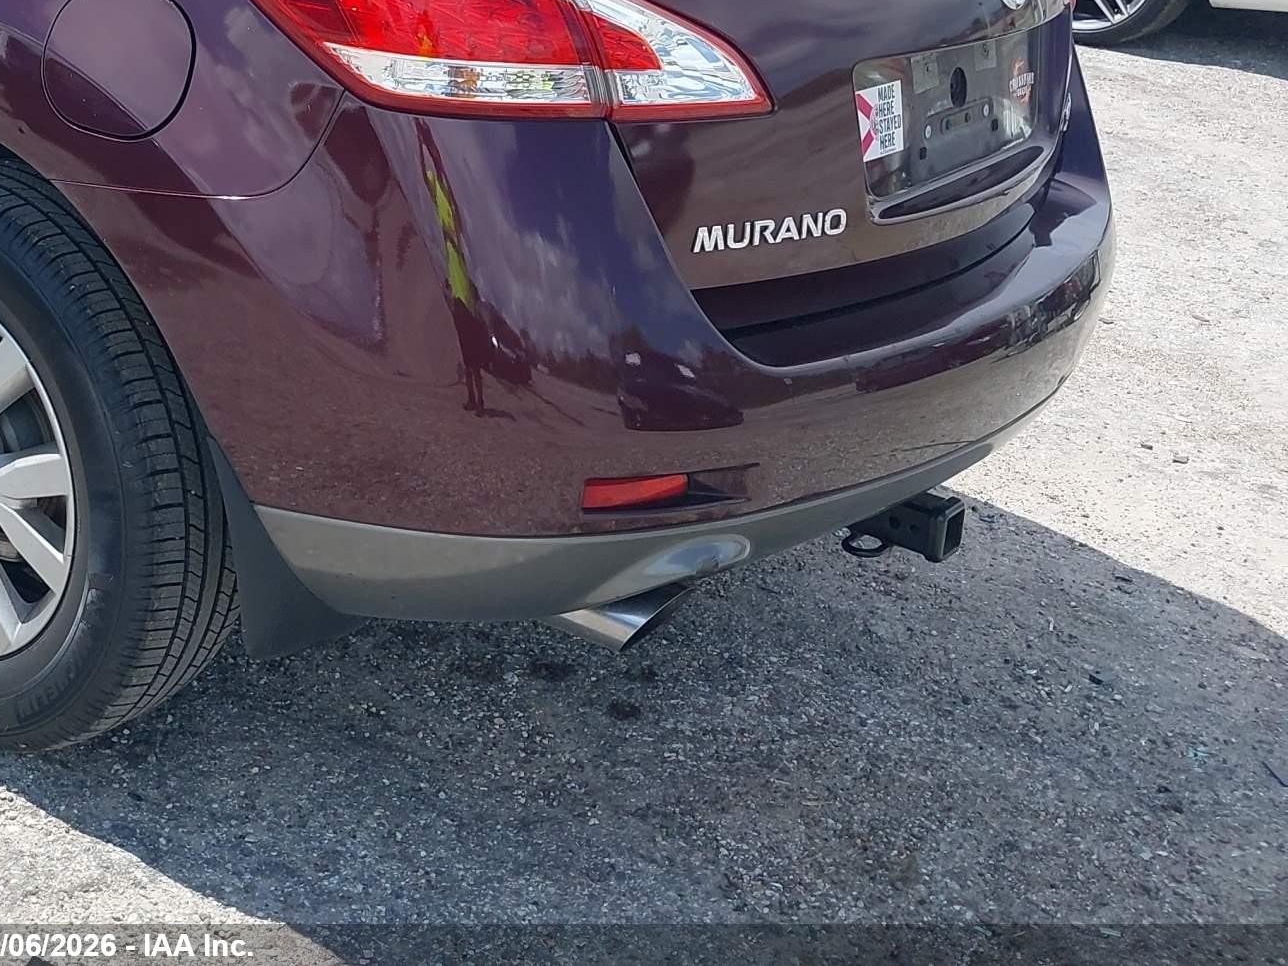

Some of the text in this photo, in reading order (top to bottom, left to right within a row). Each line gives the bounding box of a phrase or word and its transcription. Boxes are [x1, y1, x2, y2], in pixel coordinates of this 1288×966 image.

[877, 84, 895, 102] MADE
[879, 100, 895, 118] HERE
[879, 114, 902, 135] STAYED
[879, 132, 896, 151] HERE
[692, 208, 847, 253] MURANO
